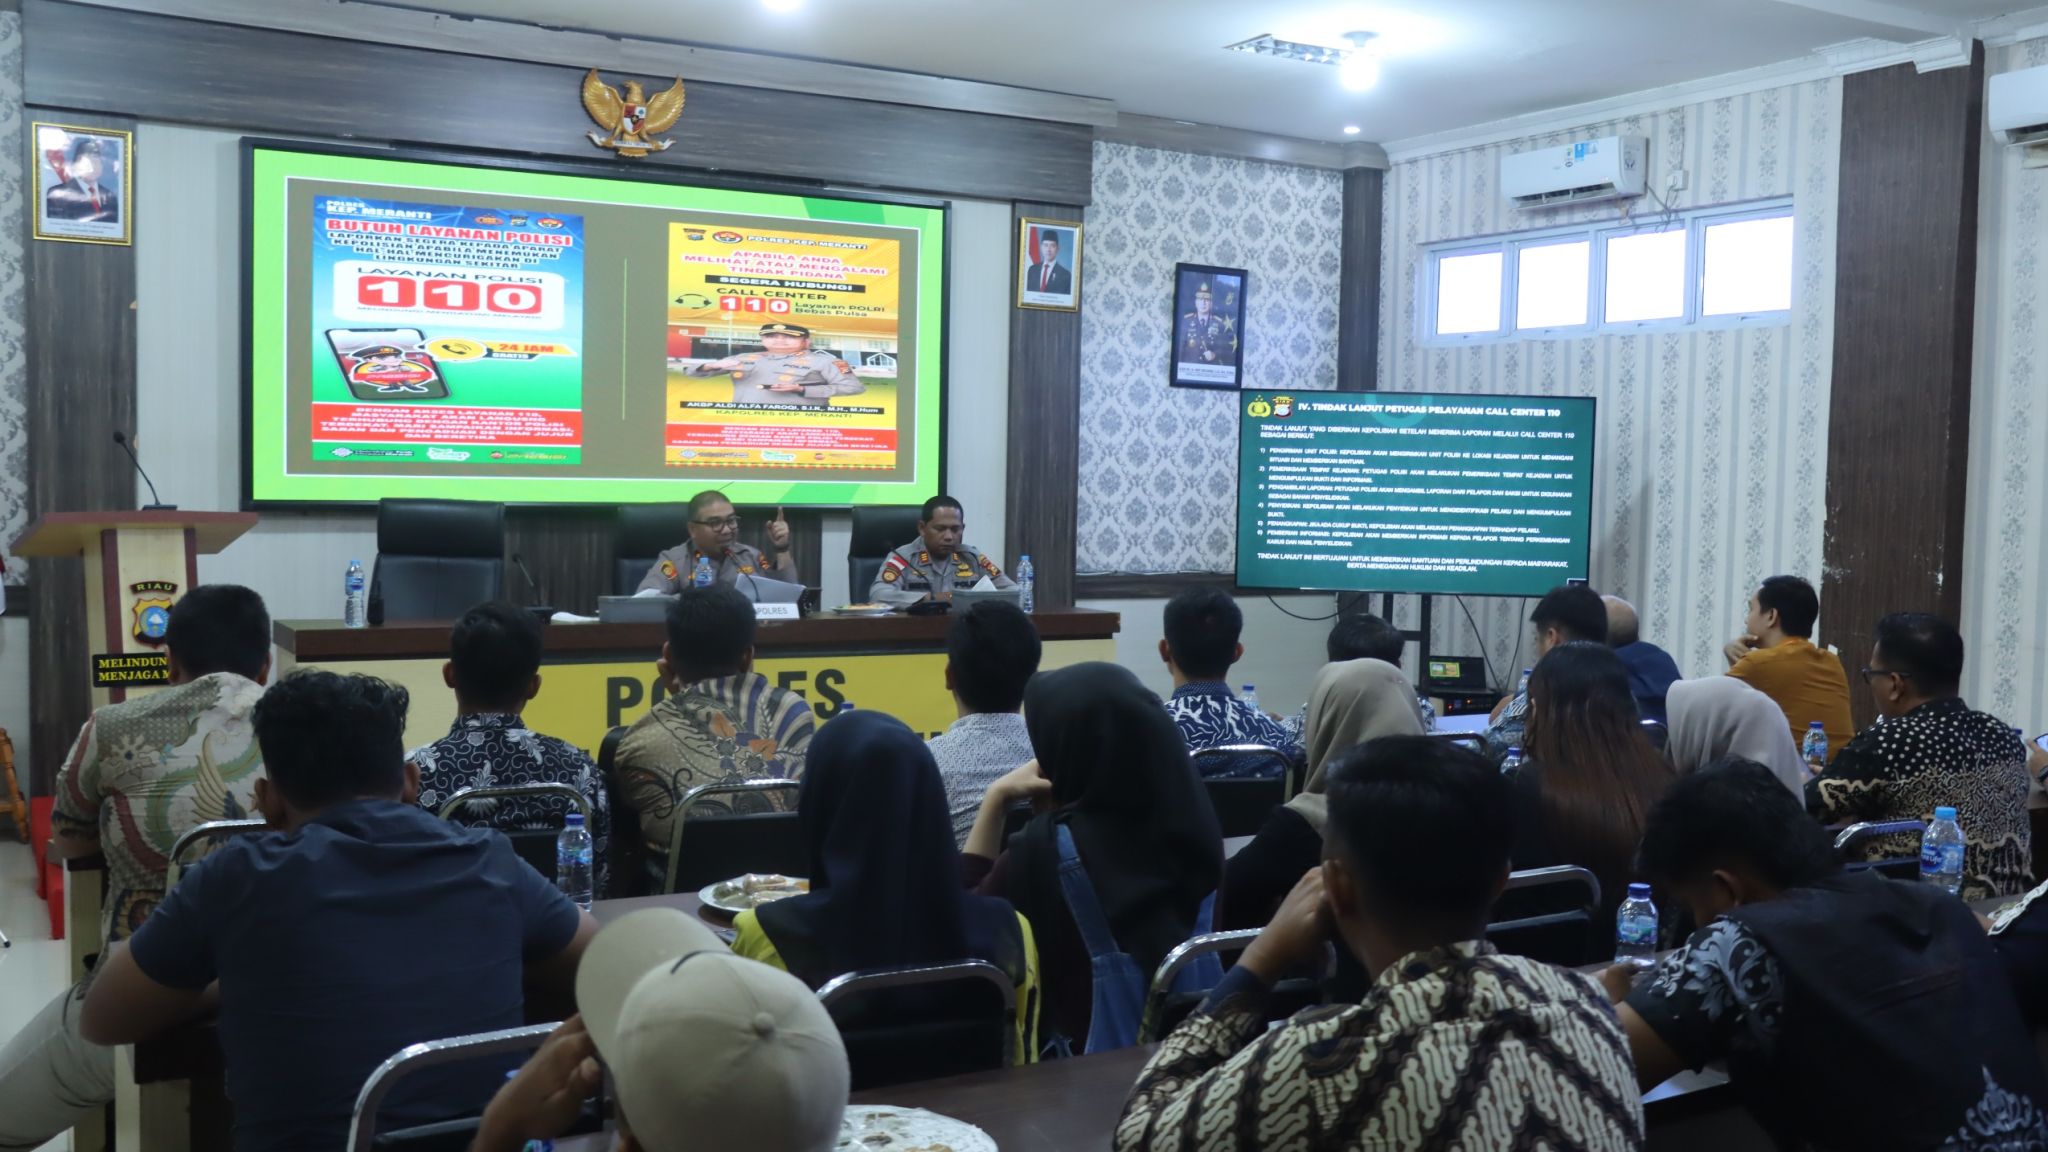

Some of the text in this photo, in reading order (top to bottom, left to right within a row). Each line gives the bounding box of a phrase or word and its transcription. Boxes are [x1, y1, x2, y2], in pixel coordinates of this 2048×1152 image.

[361, 207, 431, 219] MERANTI
[327, 219, 572, 246] BUTUH LAYANAN POLISI
[330, 232, 401, 242] LAPORKAN
[406, 237, 454, 245] SEGERA
[333, 238, 557, 258] KEPOLISIAN APABILA MENEMUKAN
[819, 241, 867, 250] MERANTI
[375, 254, 518, 268] LINGKUNGAN SEKITAR
[415, 250, 519, 262] MENCURIGAKAN
[733, 250, 794, 260] APABILA
[684, 254, 748, 264] MELIHAT
[798, 263, 884, 274] MENGALAMI
[357, 266, 542, 283] LAYANAN POLISI
[729, 266, 842, 279] TINDAK PIDANA
[720, 276, 852, 290] SEGERA HUBUNGI
[366, 279, 536, 310] 110
[716, 288, 827, 300] CALL CENTER
[722, 297, 787, 312] 110
[795, 302, 843, 310] Layanan
[136, 583, 173, 591] RIAU
[756, 606, 788, 615] POLRES
[98, 657, 168, 669] MELINDUN
[98, 670, 160, 682] MENJAGA
